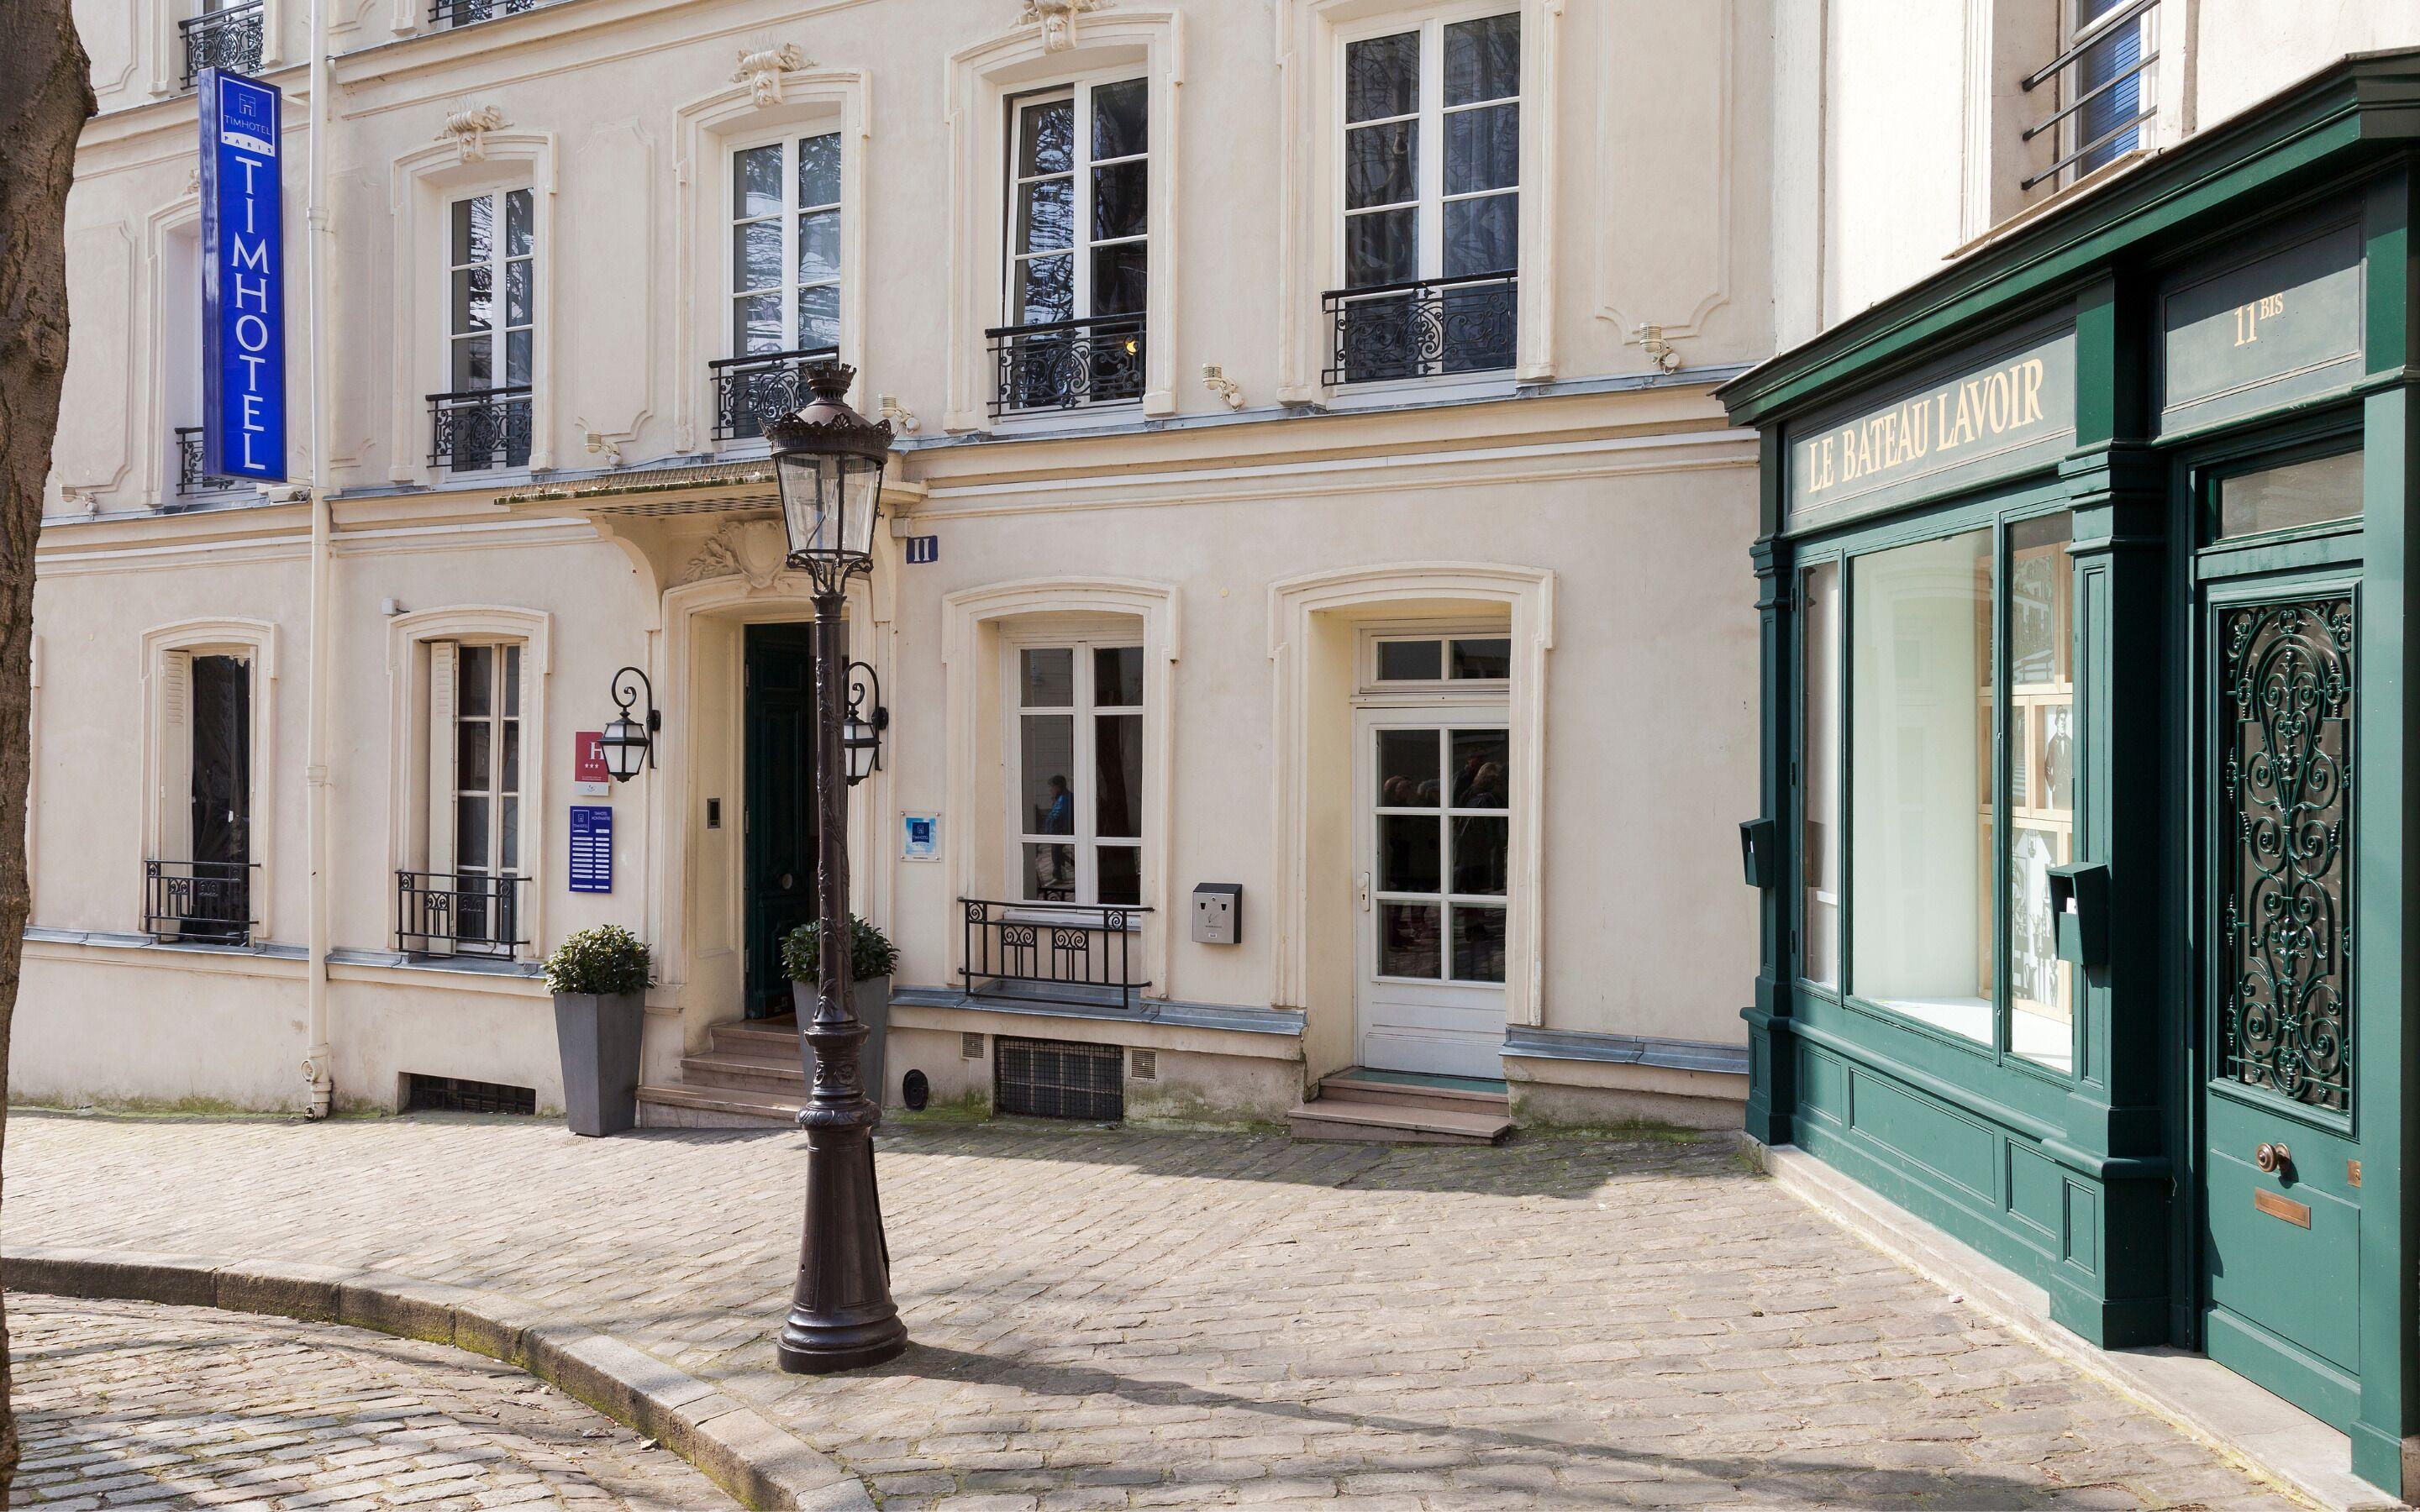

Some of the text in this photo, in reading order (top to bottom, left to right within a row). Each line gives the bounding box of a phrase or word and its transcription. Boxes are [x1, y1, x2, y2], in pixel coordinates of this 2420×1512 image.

[223, 114, 271, 136] TIMHOTEL
[224, 135, 272, 154] PARIS
[231, 155, 270, 470] TIMHOTEL
[1808, 357, 2044, 494] LE BATEAU LAVOIR
[913, 538, 930, 562] 11
[589, 742, 605, 760] H
